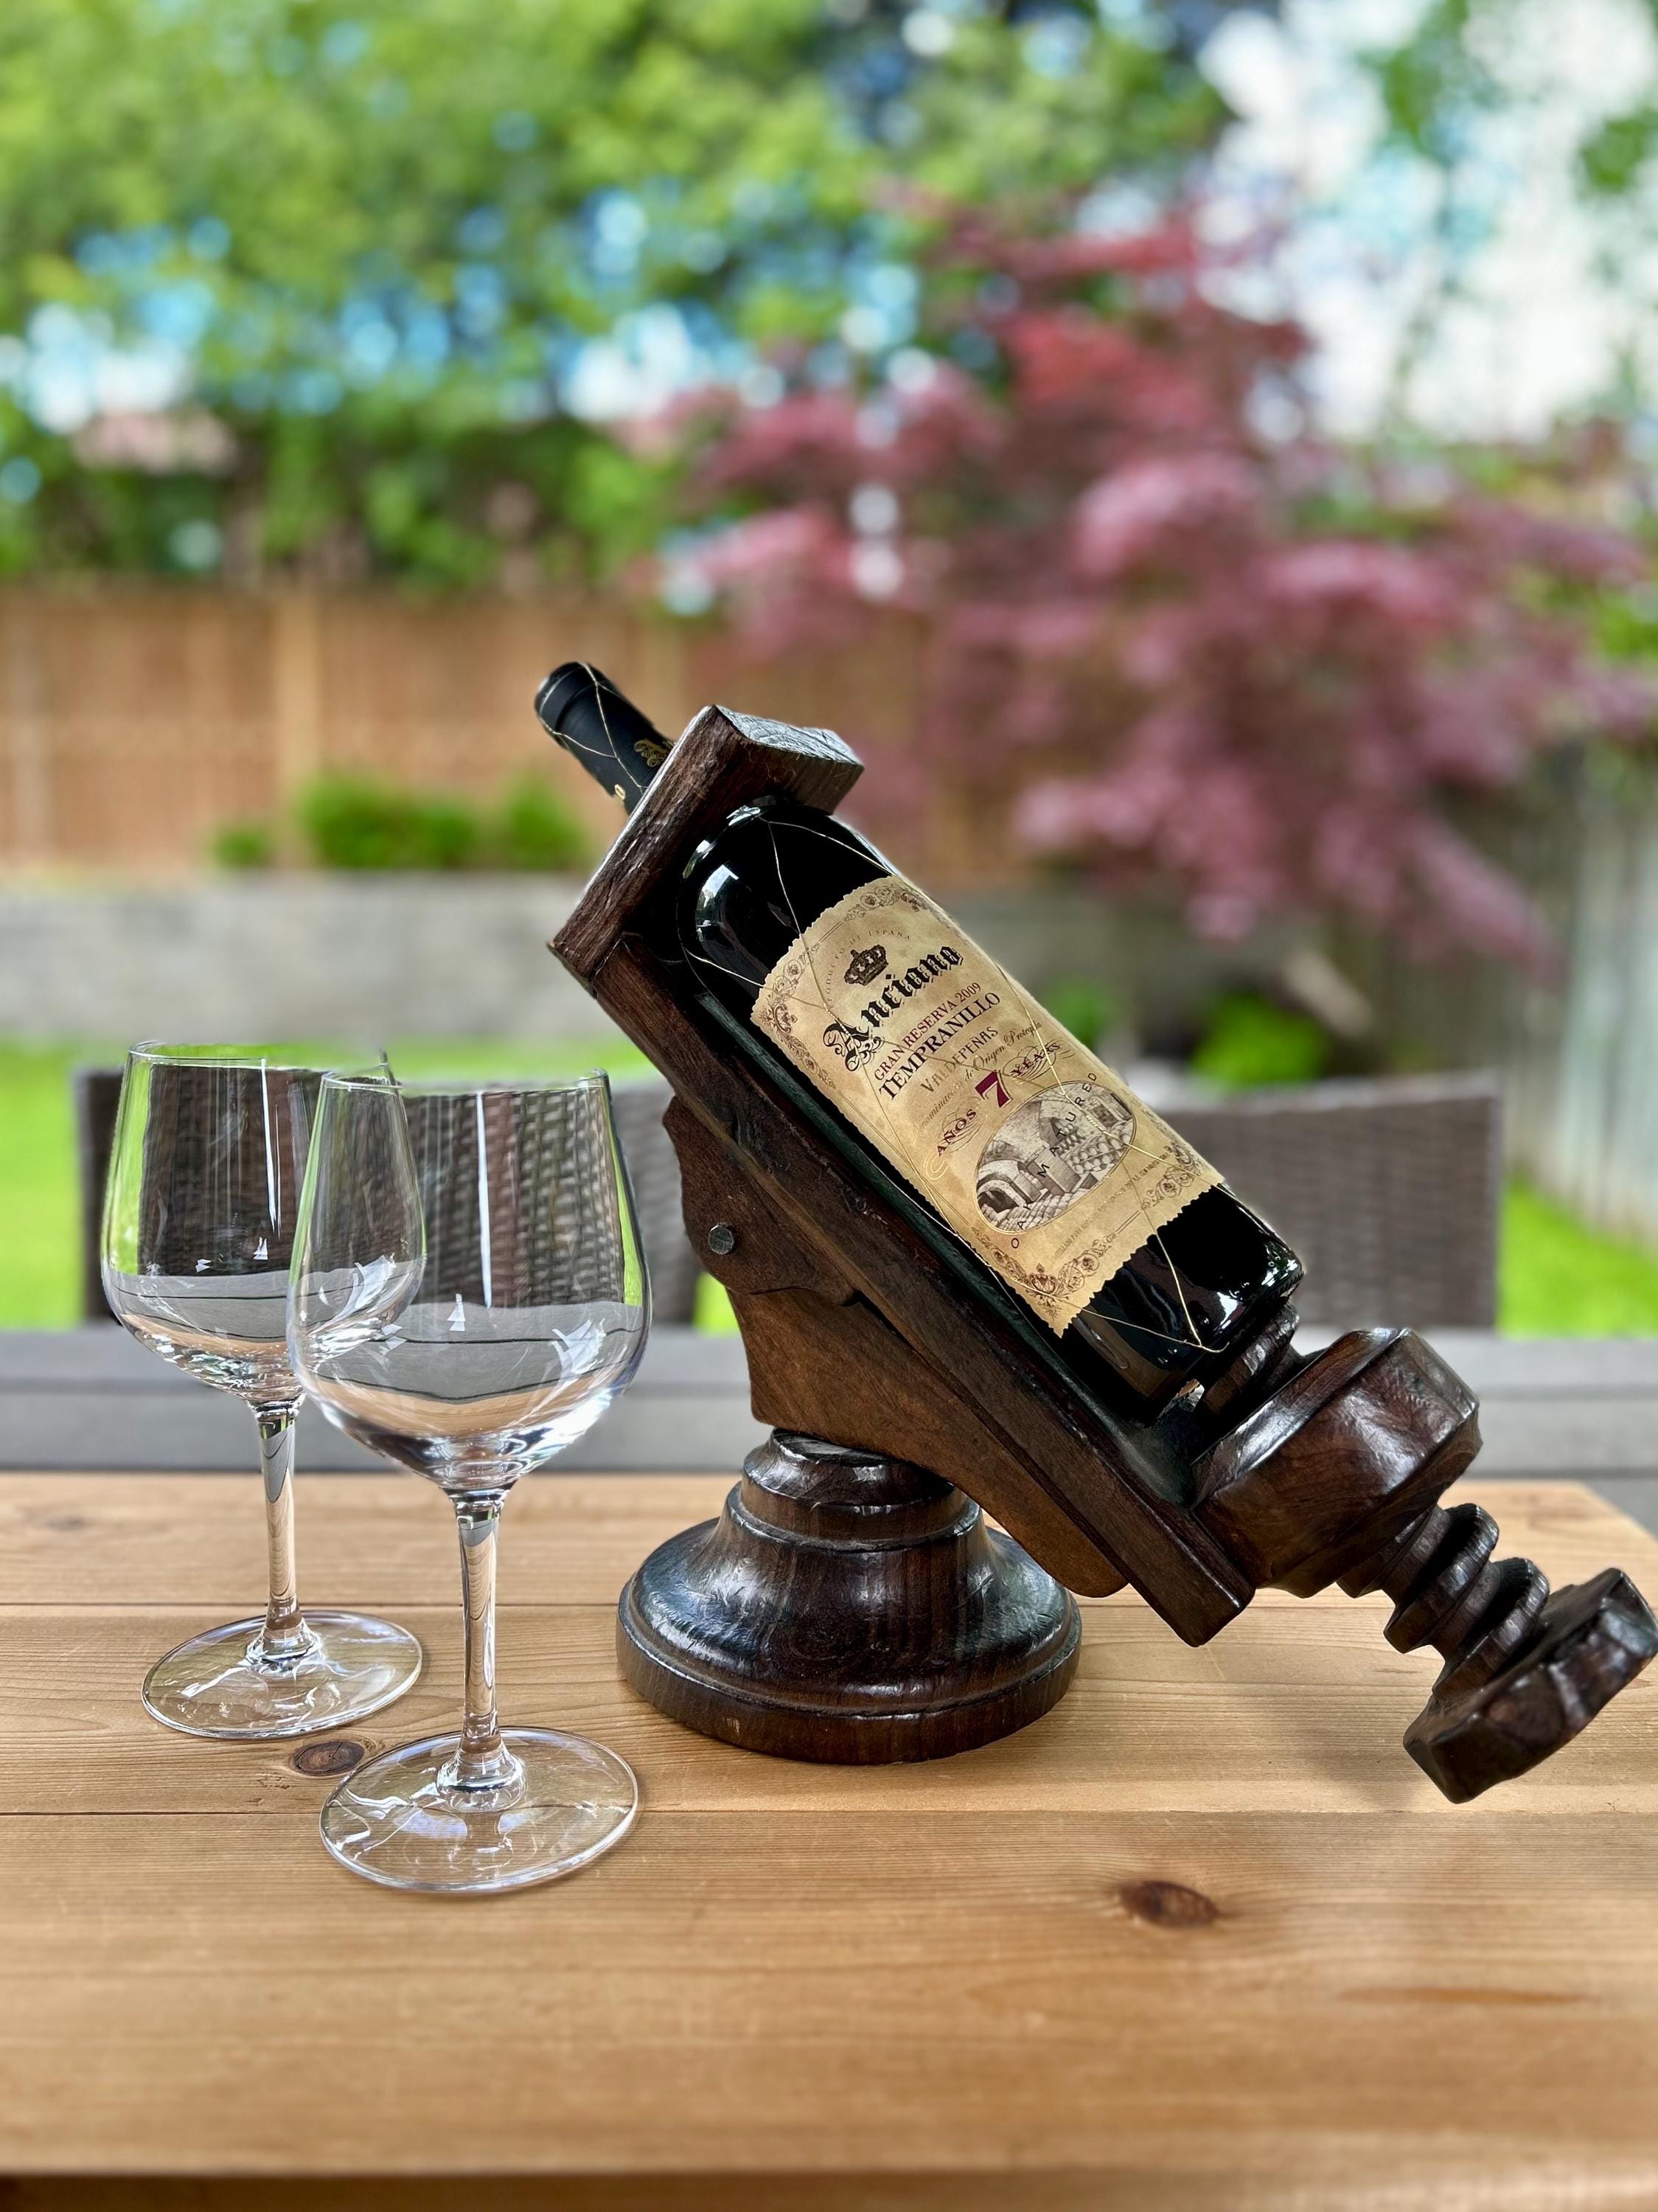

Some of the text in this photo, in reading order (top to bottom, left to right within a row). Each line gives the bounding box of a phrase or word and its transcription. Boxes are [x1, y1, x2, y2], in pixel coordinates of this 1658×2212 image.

[823, 946, 964, 1071] Anciano
[874, 982, 981, 1081] GRAN RESERVA 2009
[879, 992, 1000, 1100] TEMPRANILLO
[920, 1026, 998, 1092] VALDEPEÑAS
[937, 1043, 1060, 1156] AÑOS 7 YEARS
[965, 1068, 974, 1082] de
[972, 1045, 1005, 1070] Origen
[1037, 1072, 1098, 1178] MATURED
